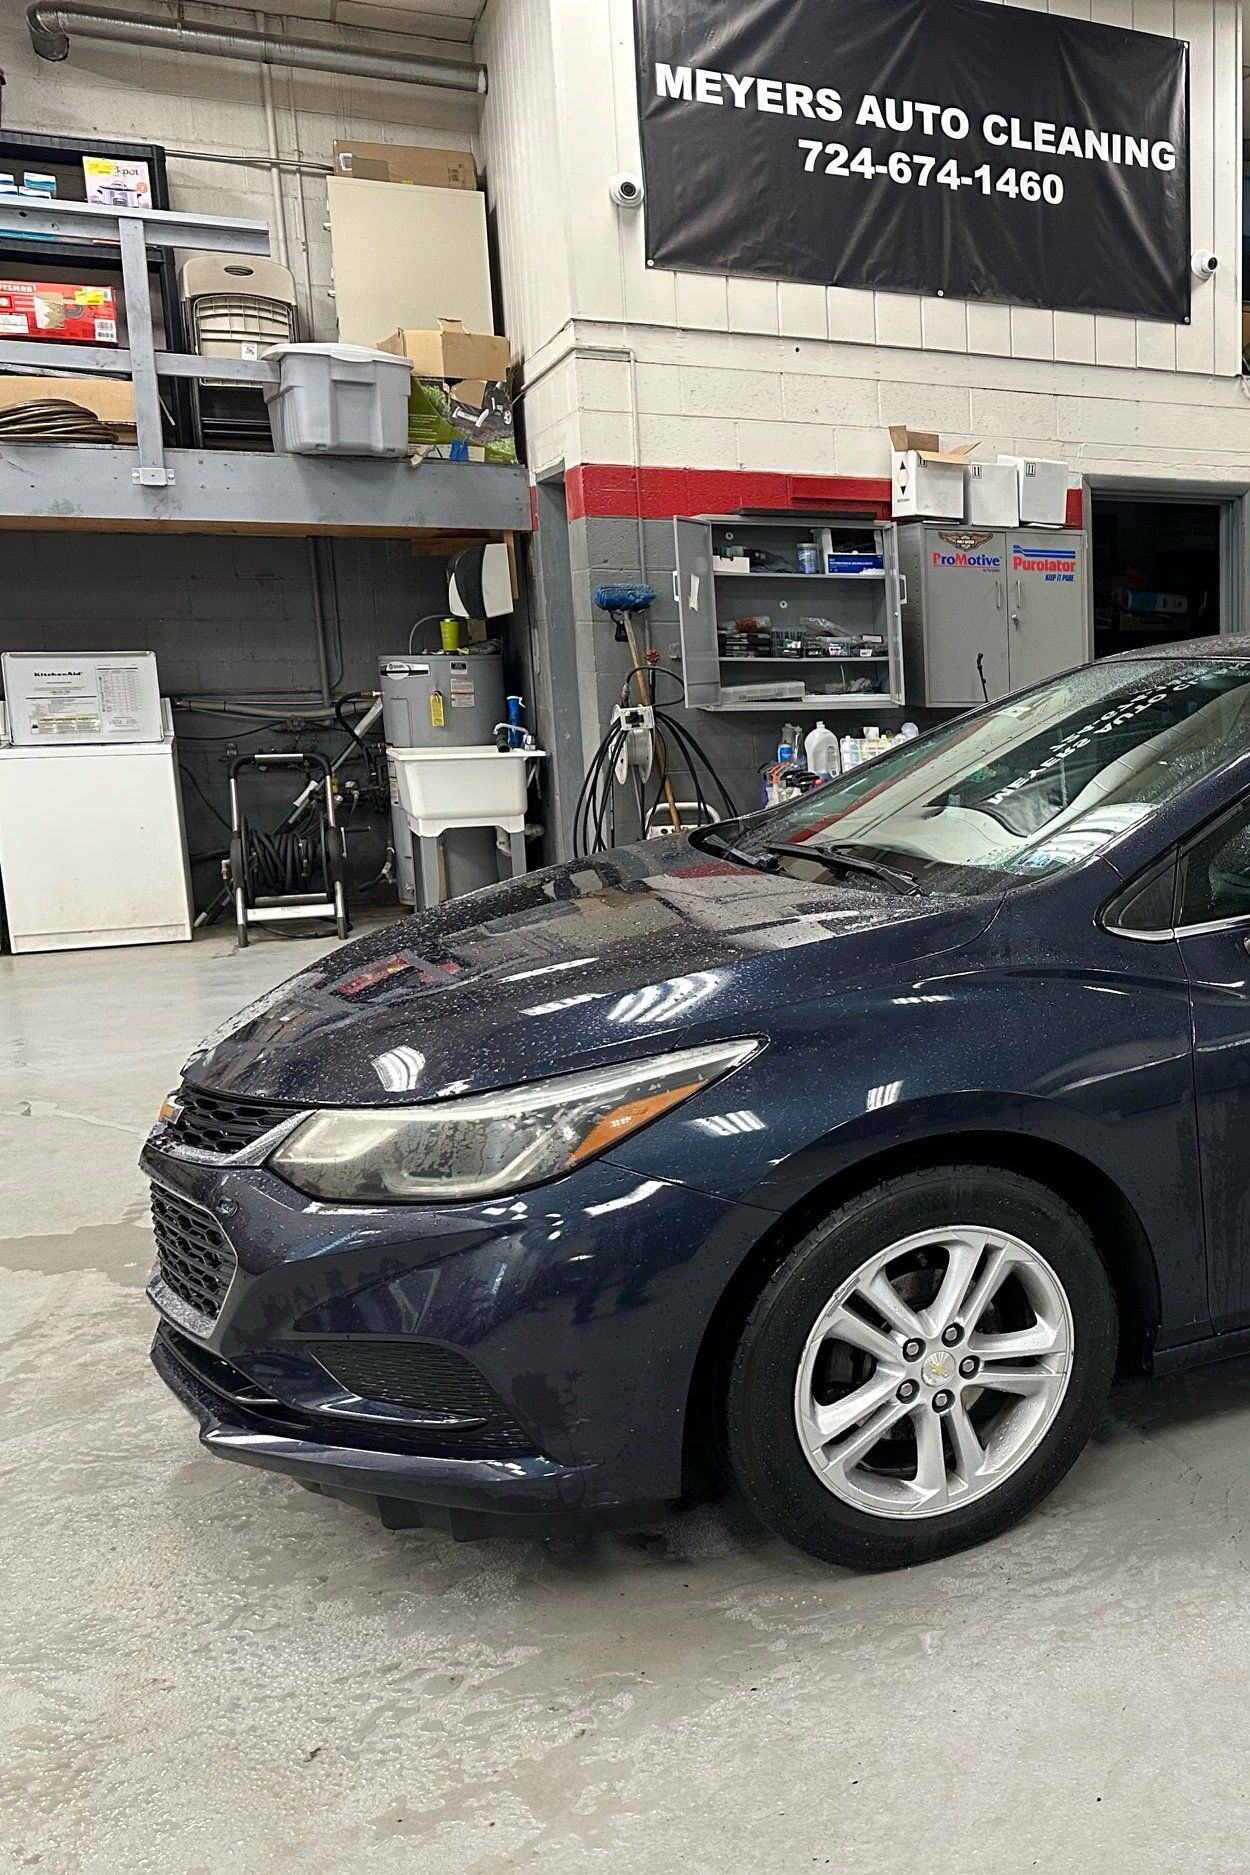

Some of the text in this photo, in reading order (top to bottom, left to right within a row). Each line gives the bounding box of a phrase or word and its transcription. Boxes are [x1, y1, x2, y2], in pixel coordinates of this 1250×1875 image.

[655, 62, 1177, 171] MEYERS AUTO CLEANING
[798, 138, 1065, 205] 724-674-1460
[932, 552, 1000, 567] ProMotive
[1013, 556, 1075, 571] Purolator
